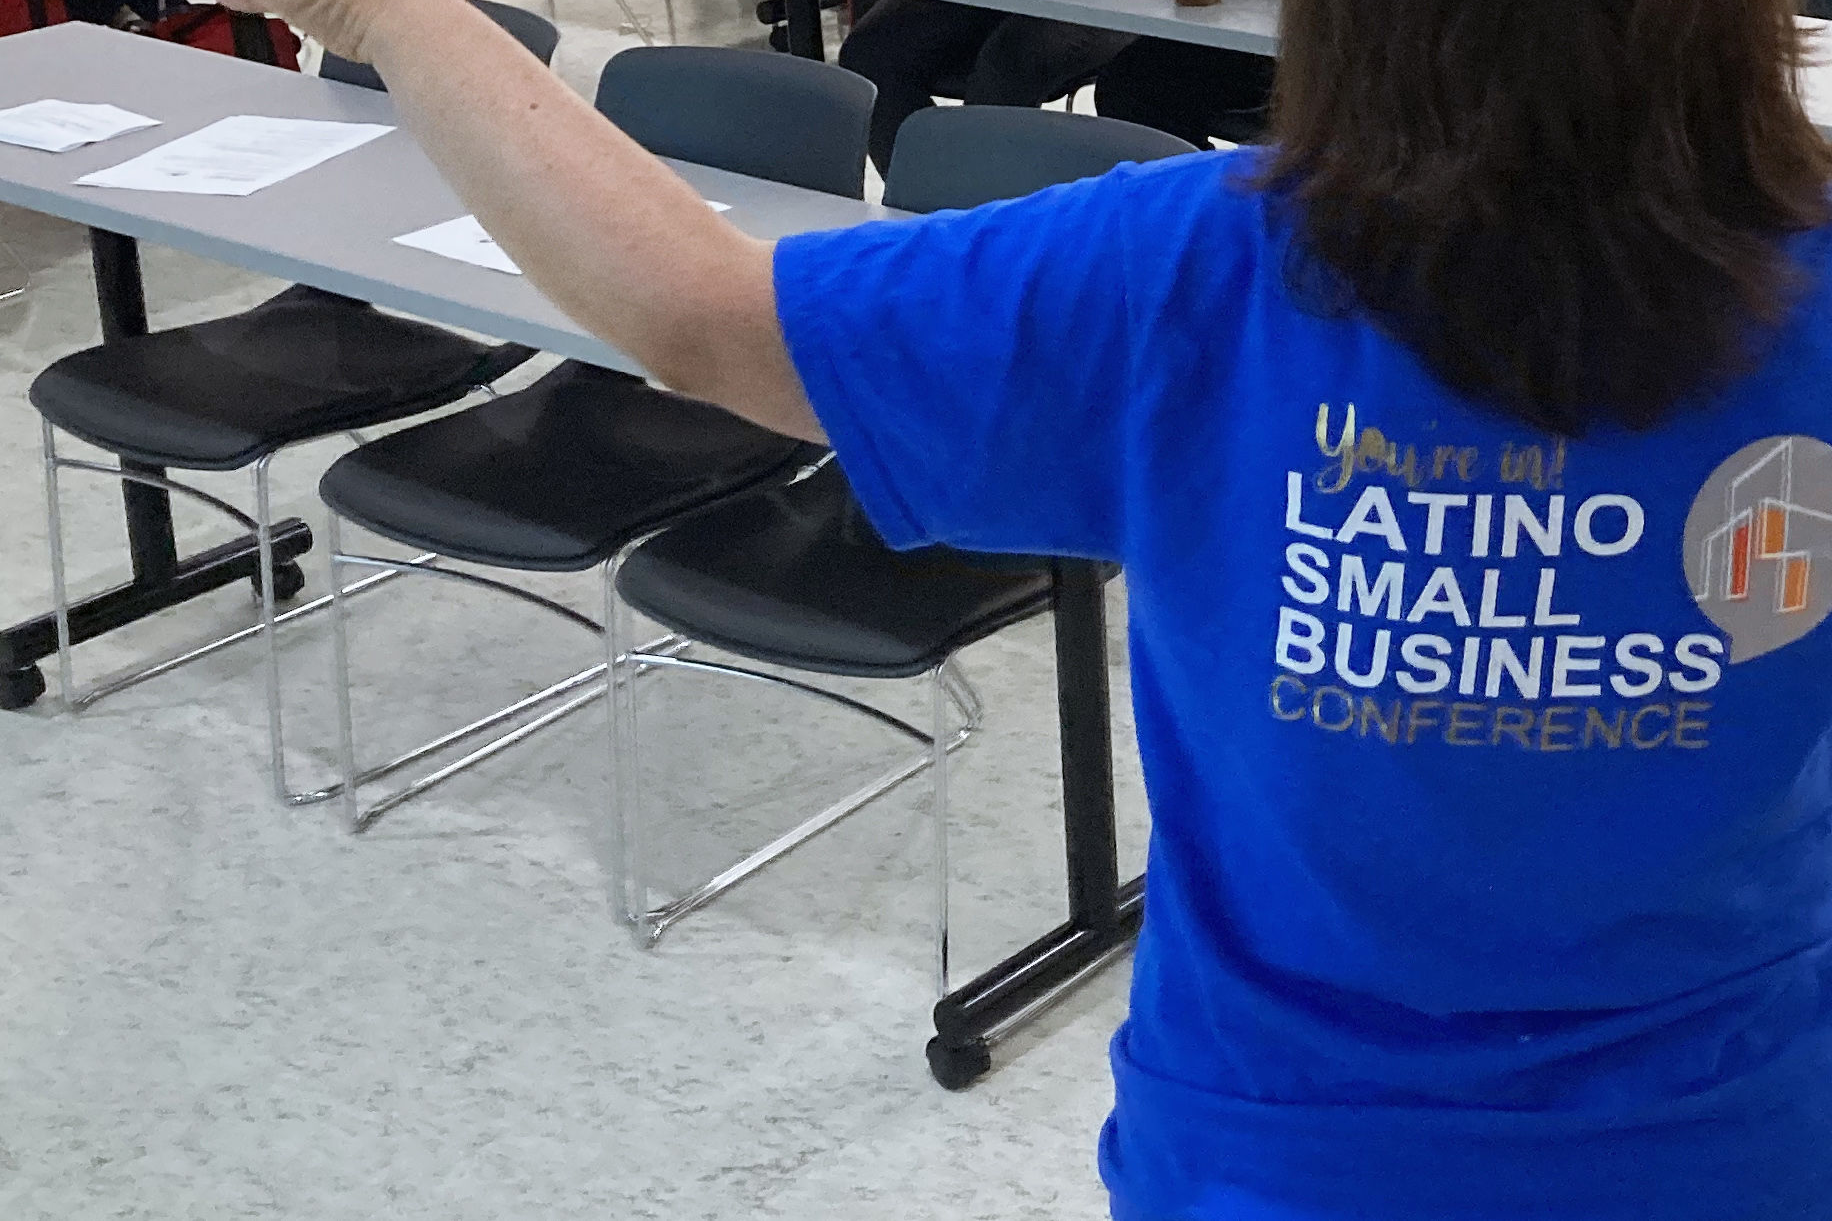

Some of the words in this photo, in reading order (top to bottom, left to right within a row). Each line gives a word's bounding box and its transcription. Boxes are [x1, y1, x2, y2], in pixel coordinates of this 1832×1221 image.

[1284, 470, 1646, 558] LATINO
[1280, 542, 1581, 628] SMALL
[1274, 606, 1723, 699] BUSINESS
[1268, 674, 1711, 753] CONFERENCE
